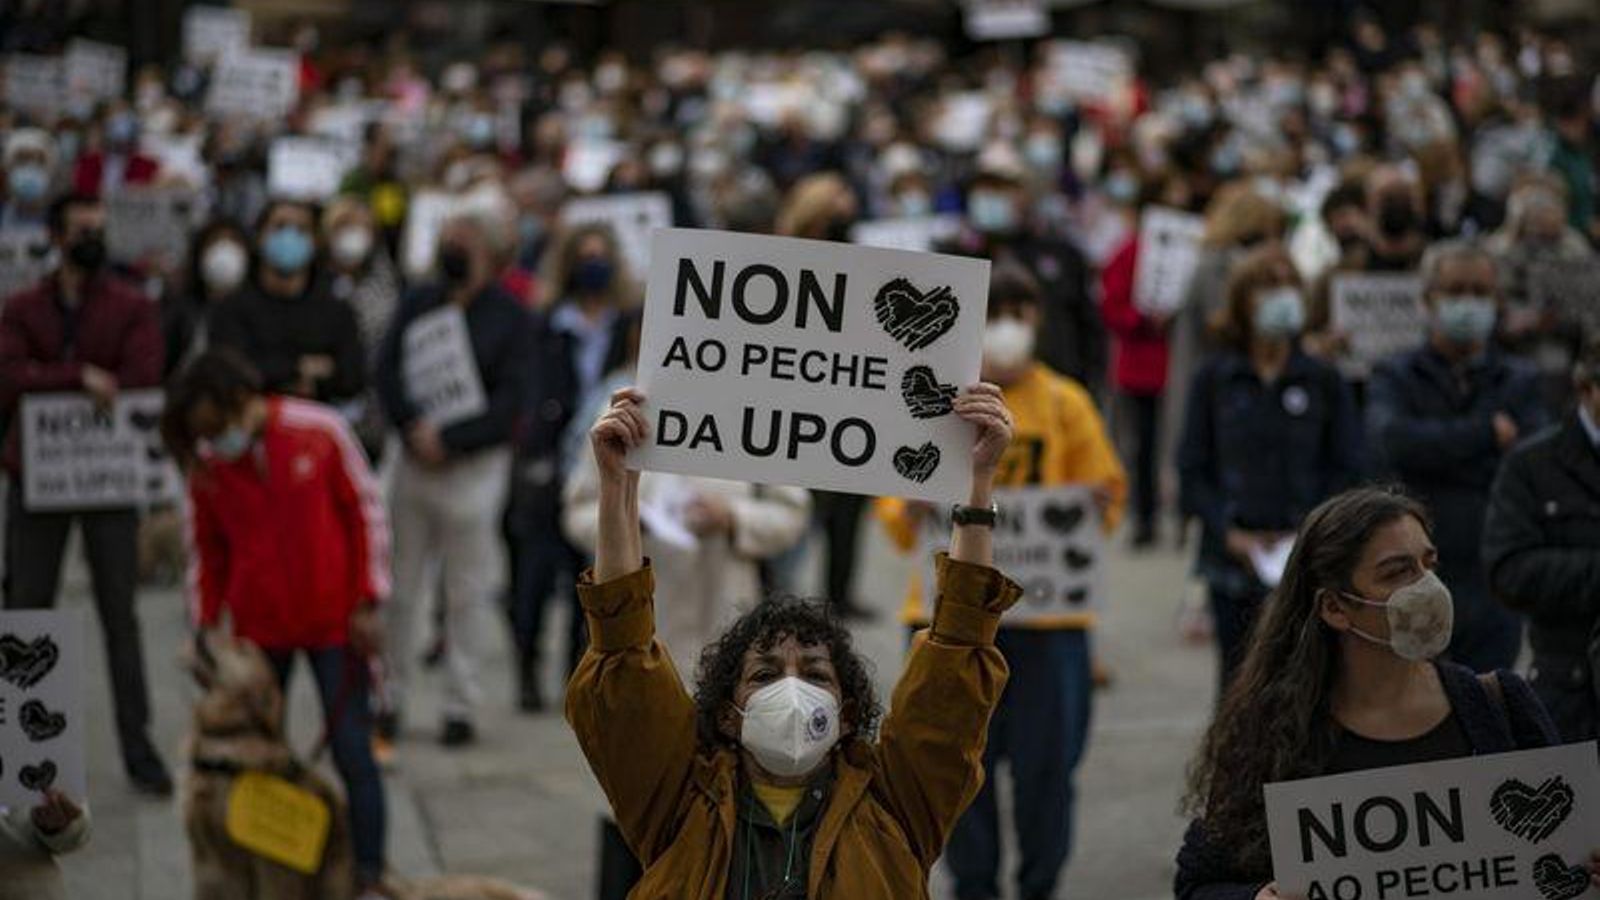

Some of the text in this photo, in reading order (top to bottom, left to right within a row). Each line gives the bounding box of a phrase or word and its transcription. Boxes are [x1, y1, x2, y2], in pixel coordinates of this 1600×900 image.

[672, 258, 847, 332] NON
[662, 336, 888, 390] AO PECHE
[656, 406, 877, 467] DA UPO
[1298, 787, 1465, 863] NON
[1307, 854, 1519, 900] AO PECHE
